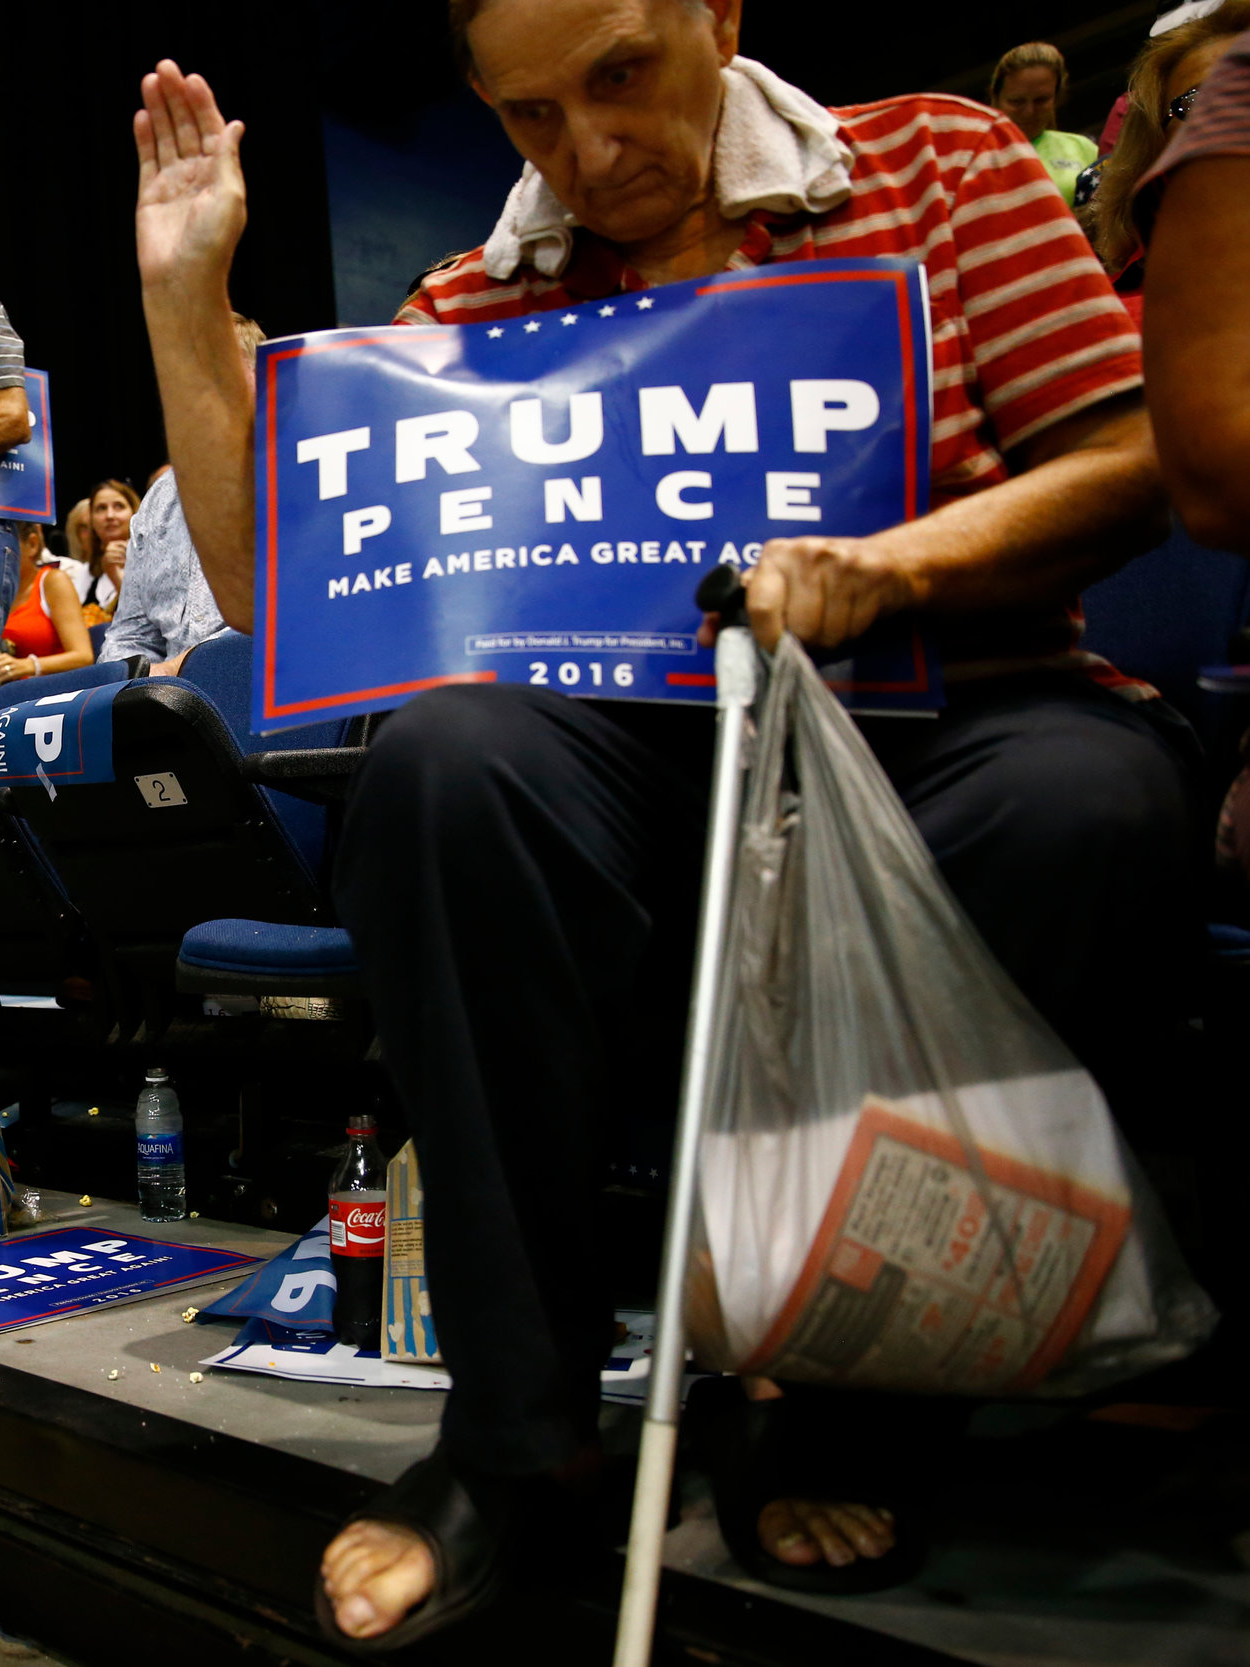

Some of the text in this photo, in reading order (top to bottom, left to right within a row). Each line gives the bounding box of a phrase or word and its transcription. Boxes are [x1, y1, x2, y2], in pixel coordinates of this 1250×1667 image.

[297, 378, 881, 501] TRUMP
[342, 469, 822, 556] PENCE
[327, 562, 414, 600] MAKE
[421, 542, 580, 580] AMERICA
[590, 540, 707, 565] GREAT
[527, 635, 561, 648] Donald
[571, 635, 603, 649] Trump
[604, 635, 618, 648] for
[528, 660, 635, 688] 2016
[151, 779, 171, 802] 2
[137, 1143, 174, 1155] AQUAFINA
[66, 1269, 119, 1287] GREAT
[120, 1254, 174, 1273] AGAIN!
[91, 1288, 143, 1303] 2016
